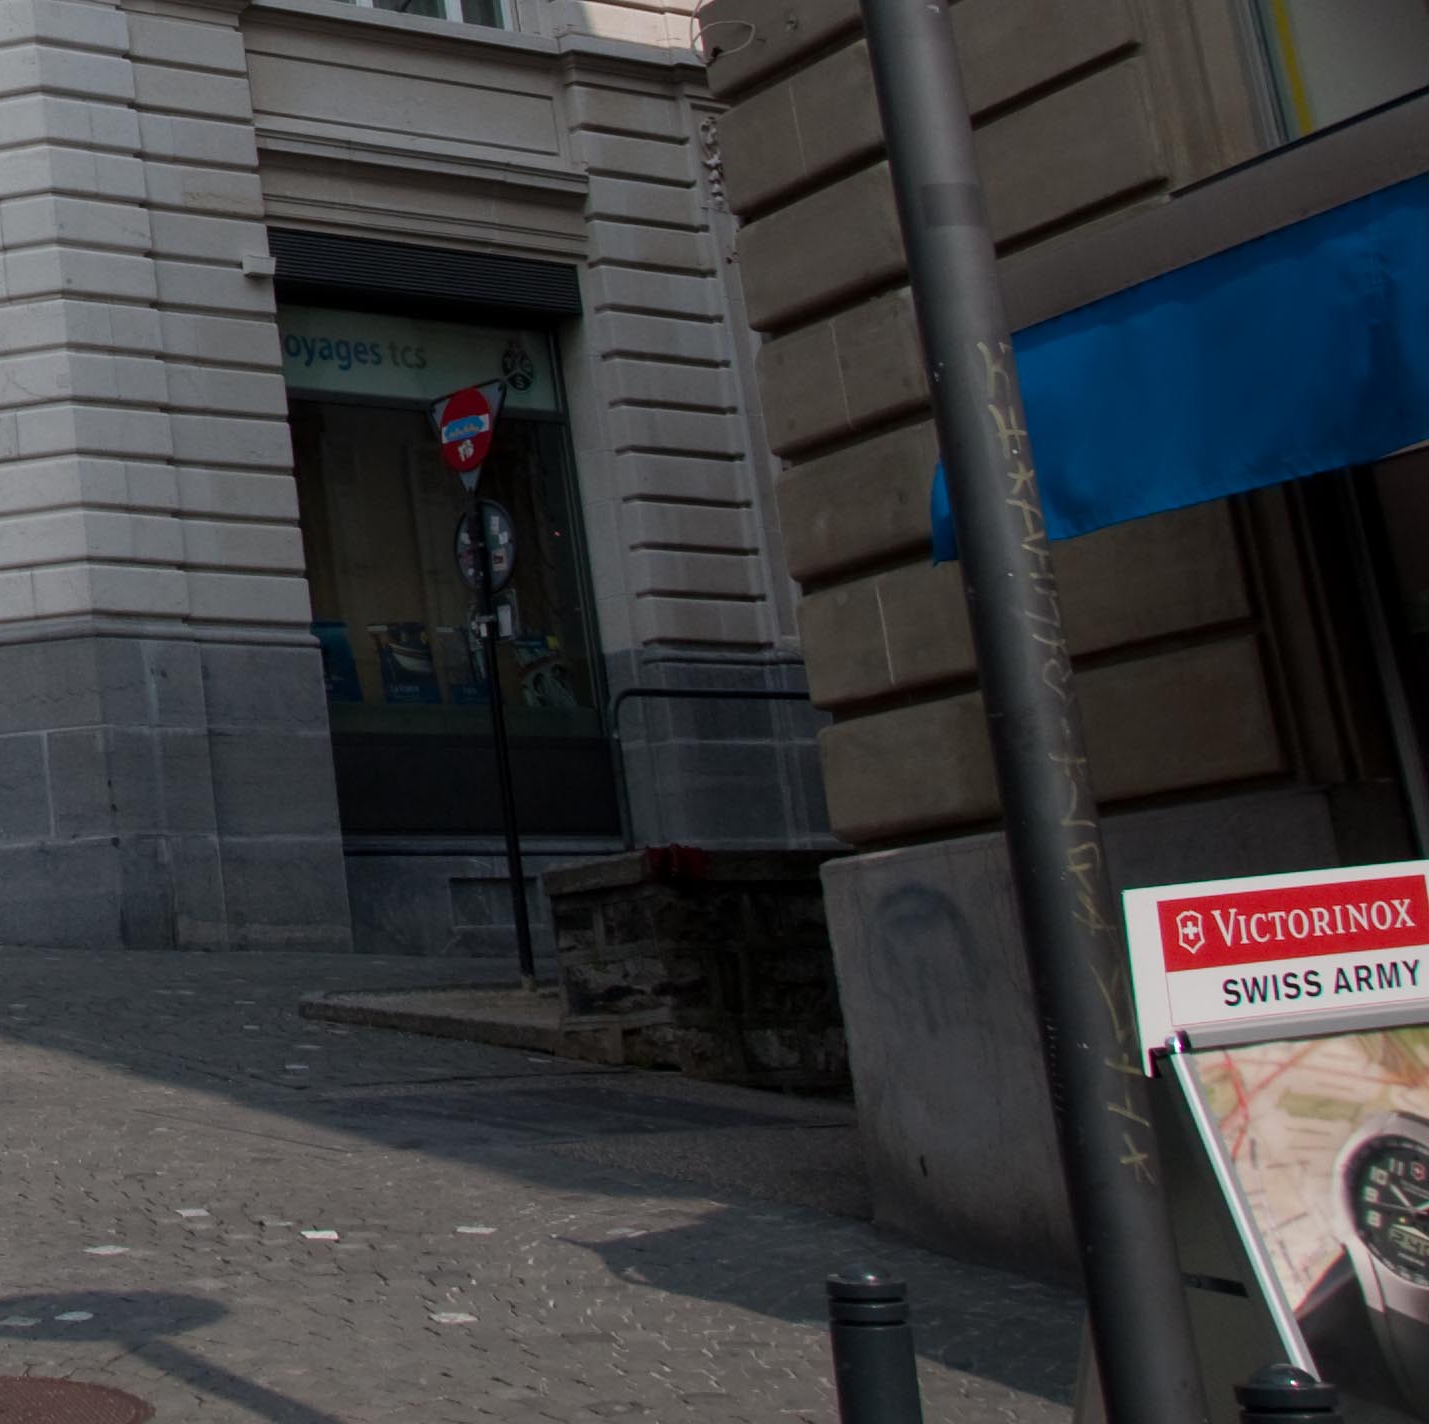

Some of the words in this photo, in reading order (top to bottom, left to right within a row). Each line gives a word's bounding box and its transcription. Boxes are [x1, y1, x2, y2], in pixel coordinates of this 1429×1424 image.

[283, 333, 382, 370] oyages
[388, 340, 428, 370] tcs
[1222, 969, 1323, 1007] SWISS
[1333, 959, 1420, 995] ARMY
